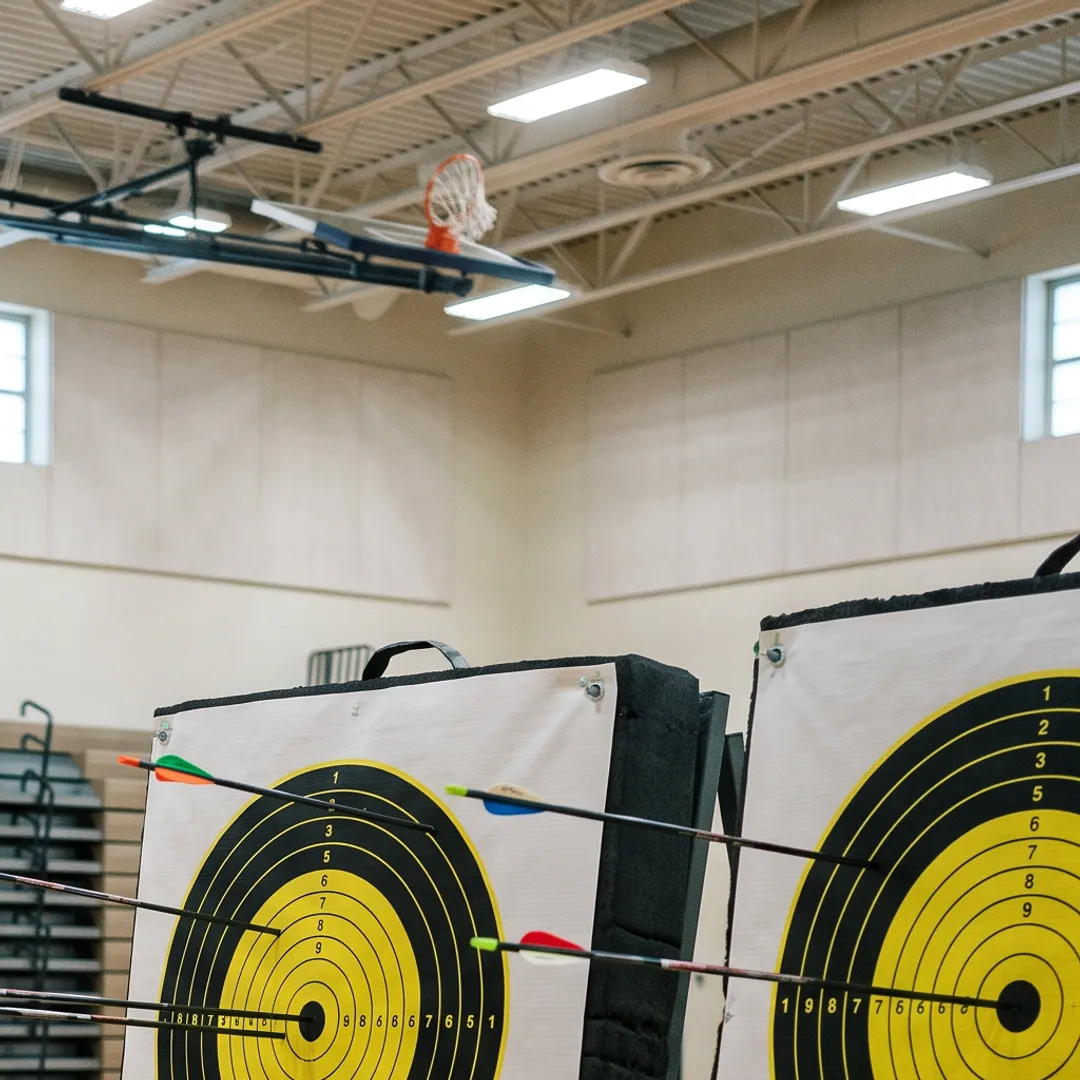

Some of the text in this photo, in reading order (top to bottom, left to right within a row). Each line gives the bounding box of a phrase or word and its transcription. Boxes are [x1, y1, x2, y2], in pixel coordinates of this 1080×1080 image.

[1042, 685, 1051, 701] 1
[1037, 719, 1050, 736] 2
[1035, 751, 1046, 769] 3
[333, 771, 339, 784] 1
[1032, 785, 1043, 802] 5
[325, 824, 333, 838] 3
[1029, 815, 1040, 832] 6
[323, 850, 331, 863] 5
[1027, 844, 1038, 860] 7
[320, 874, 328, 888] 6
[1024, 873, 1035, 890] 8
[319, 896, 327, 909] 7
[1022, 901, 1033, 919] 9
[317, 919, 324, 932] 8
[315, 941, 322, 955] 9
[781, 997, 789, 1013] 1
[804, 997, 814, 1014] 9
[827, 997, 837, 1014] 8
[852, 998, 862, 1014] 7
[875, 999, 884, 1015] 7
[191, 1013, 199, 1026] 8
[207, 1014, 215, 1027] 7
[343, 1014, 350, 1028] 9
[359, 1014, 367, 1028] 8
[425, 1014, 433, 1029] 7
[444, 1014, 454, 1029] 6
[466, 1014, 475, 1029] 5
[488, 1014, 495, 1029] 1
